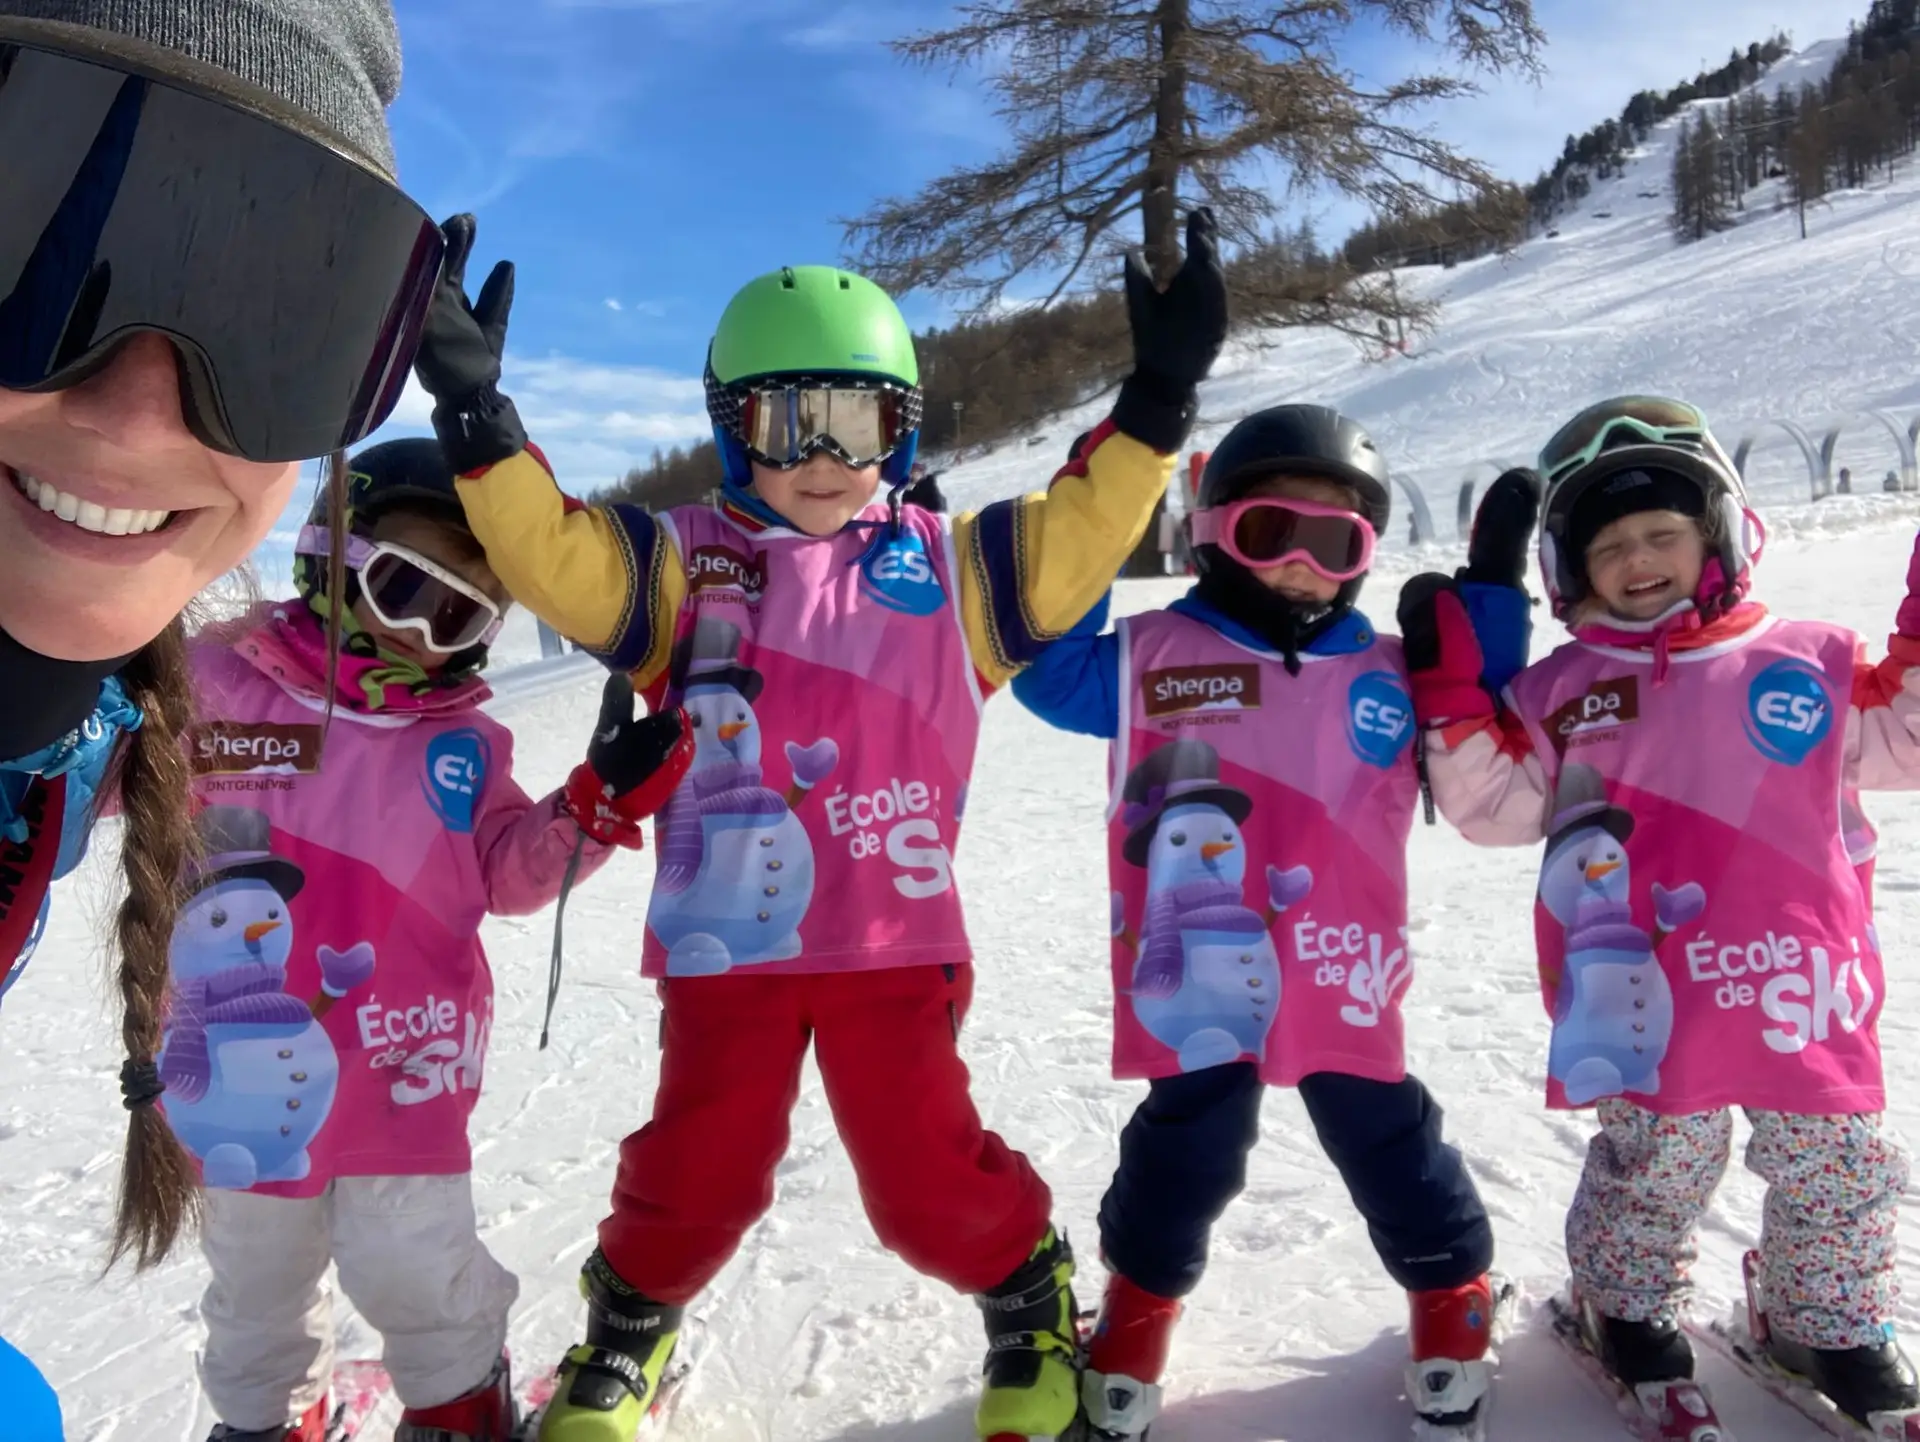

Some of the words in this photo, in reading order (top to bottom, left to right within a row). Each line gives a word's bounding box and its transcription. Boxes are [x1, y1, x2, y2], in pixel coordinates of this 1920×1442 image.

[1155, 676, 1244, 701] sherpa
[198, 731, 300, 761] sherpa
[824, 777, 931, 837] École
[849, 829, 882, 860] de
[1685, 930, 1803, 983] École
[1315, 960, 1347, 987] de
[1714, 980, 1756, 1010] de
[356, 993, 458, 1050] École
[369, 1045, 408, 1070] de
